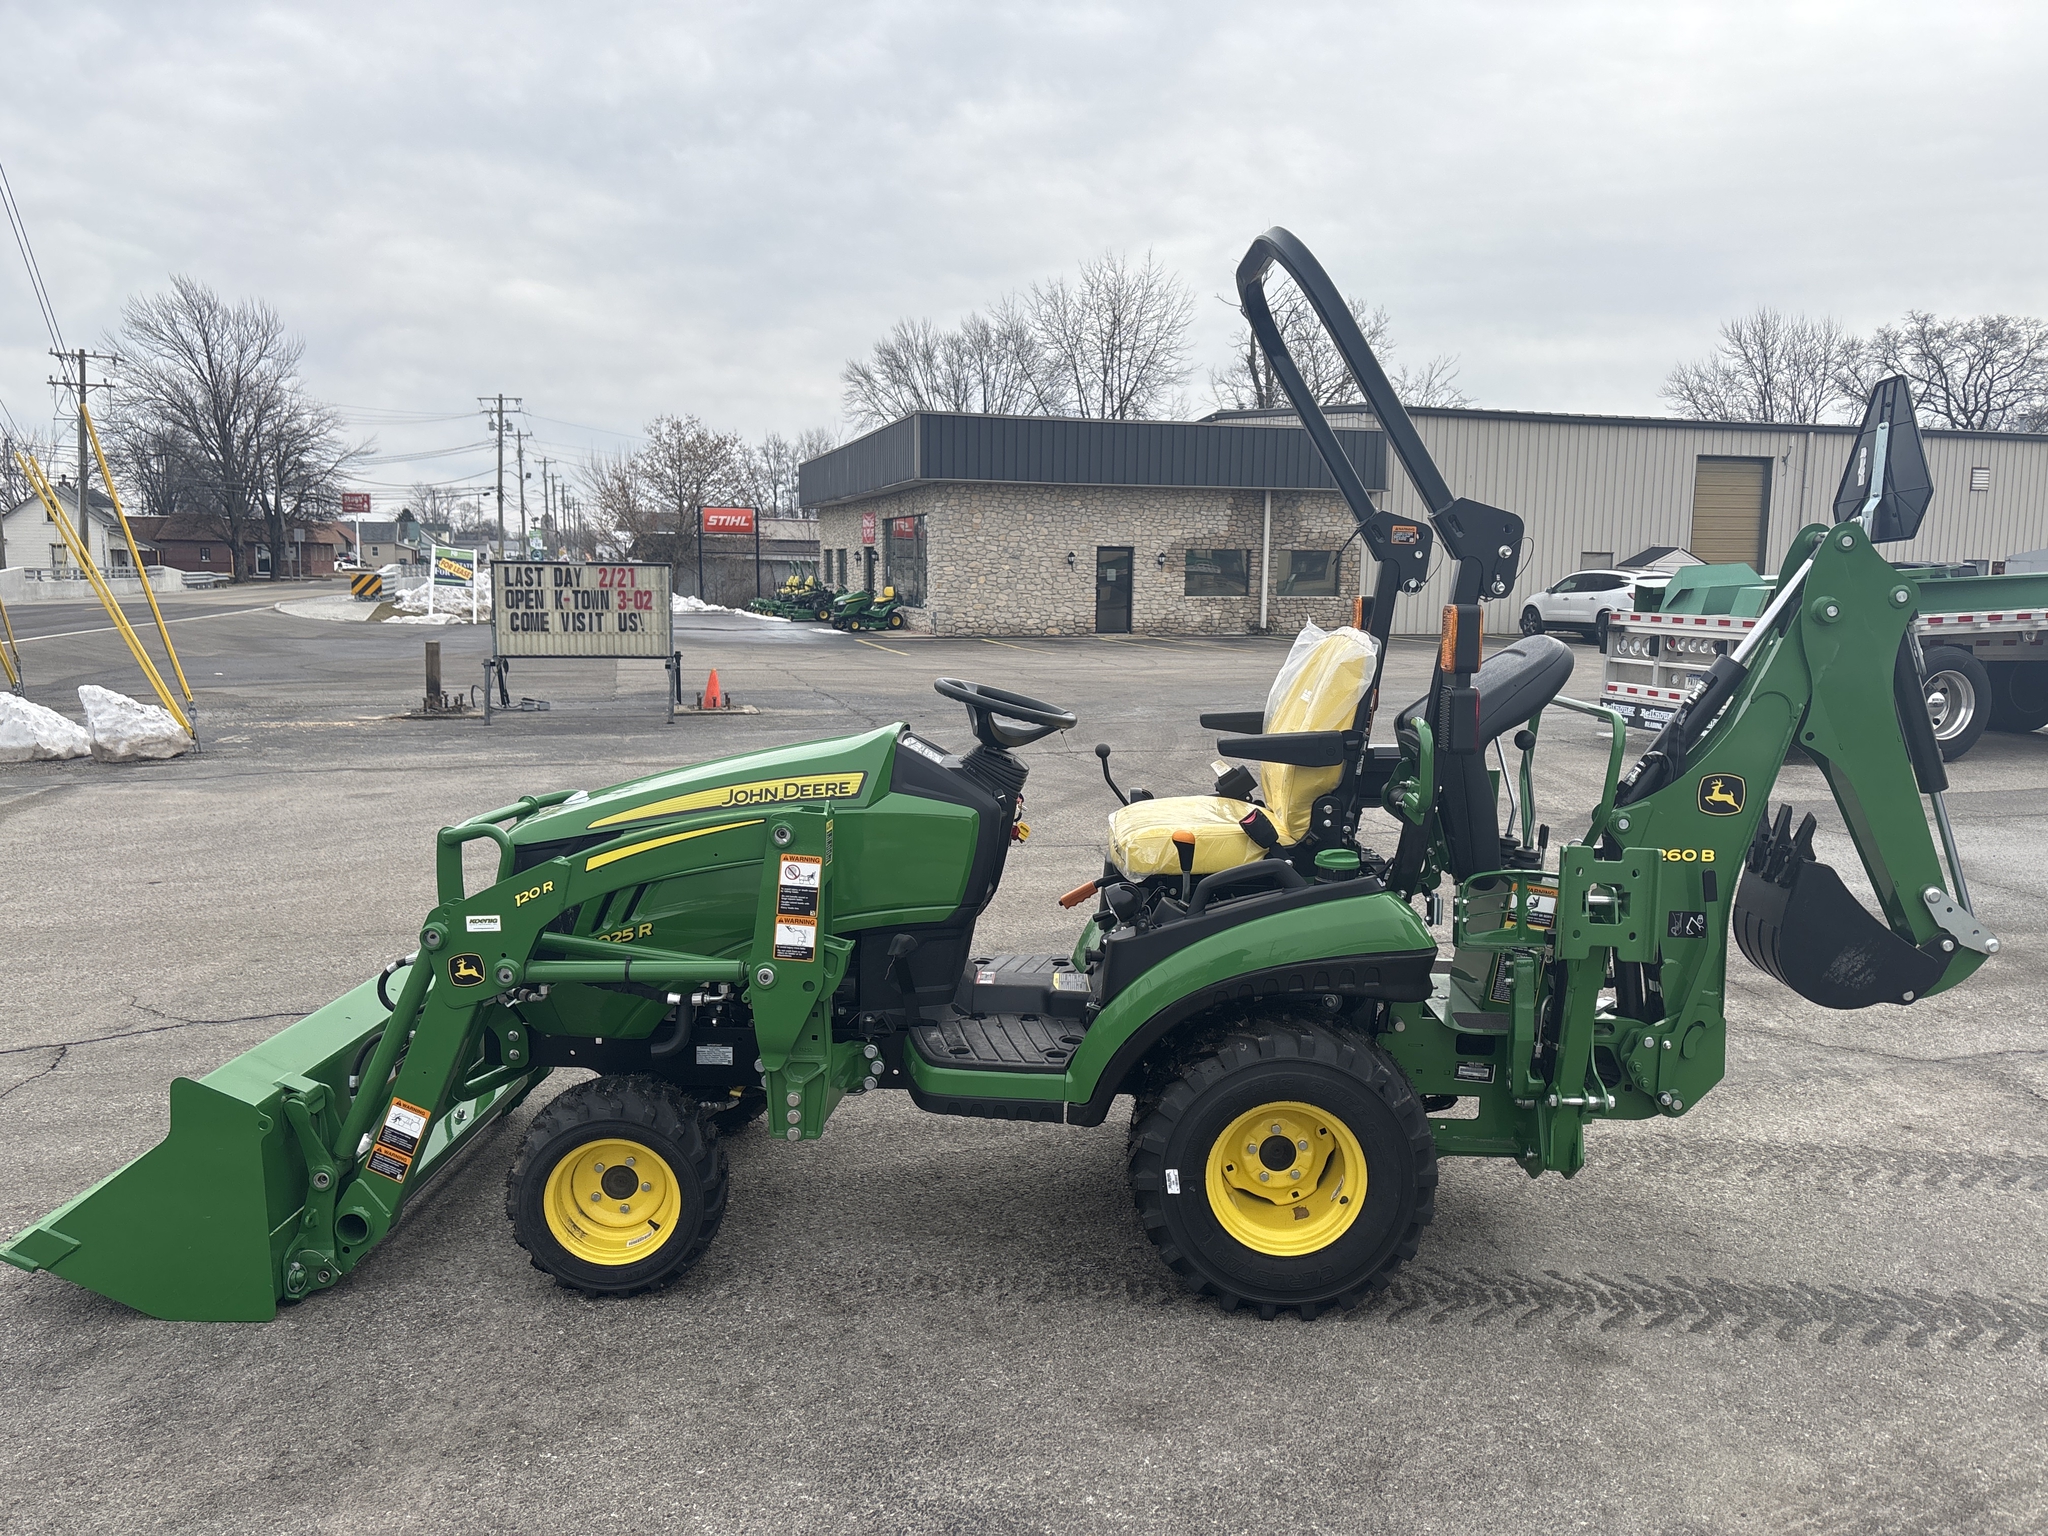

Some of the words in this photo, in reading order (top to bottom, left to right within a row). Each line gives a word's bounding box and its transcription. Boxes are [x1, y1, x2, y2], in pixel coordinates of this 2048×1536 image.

[707, 515, 749, 526] STIHL
[441, 560, 453, 571] FOR
[454, 566, 471, 579] LEASE
[504, 567, 543, 587] LAST
[553, 567, 581, 587] DAY
[598, 568, 635, 588] 2/21
[505, 590, 544, 610] OPEN
[555, 590, 610, 610] K-TOWN
[617, 590, 652, 610] 3-02
[510, 612, 549, 632] COME
[561, 612, 604, 632] VISIT
[618, 612, 645, 632] US!
[722, 787, 778, 805] JOHN
[783, 782, 850, 799] DEERE
[789, 855, 820, 864] WARNING
[1701, 849, 1715, 862] B
[514, 886, 541, 907] 120
[543, 881, 554, 894] R
[1528, 888, 1555, 896] ARNING
[784, 918, 815, 926] WARNING
[638, 922, 653, 938] R
[402, 1102, 426, 1116] WARNING
[383, 1148, 408, 1163] WARNING
